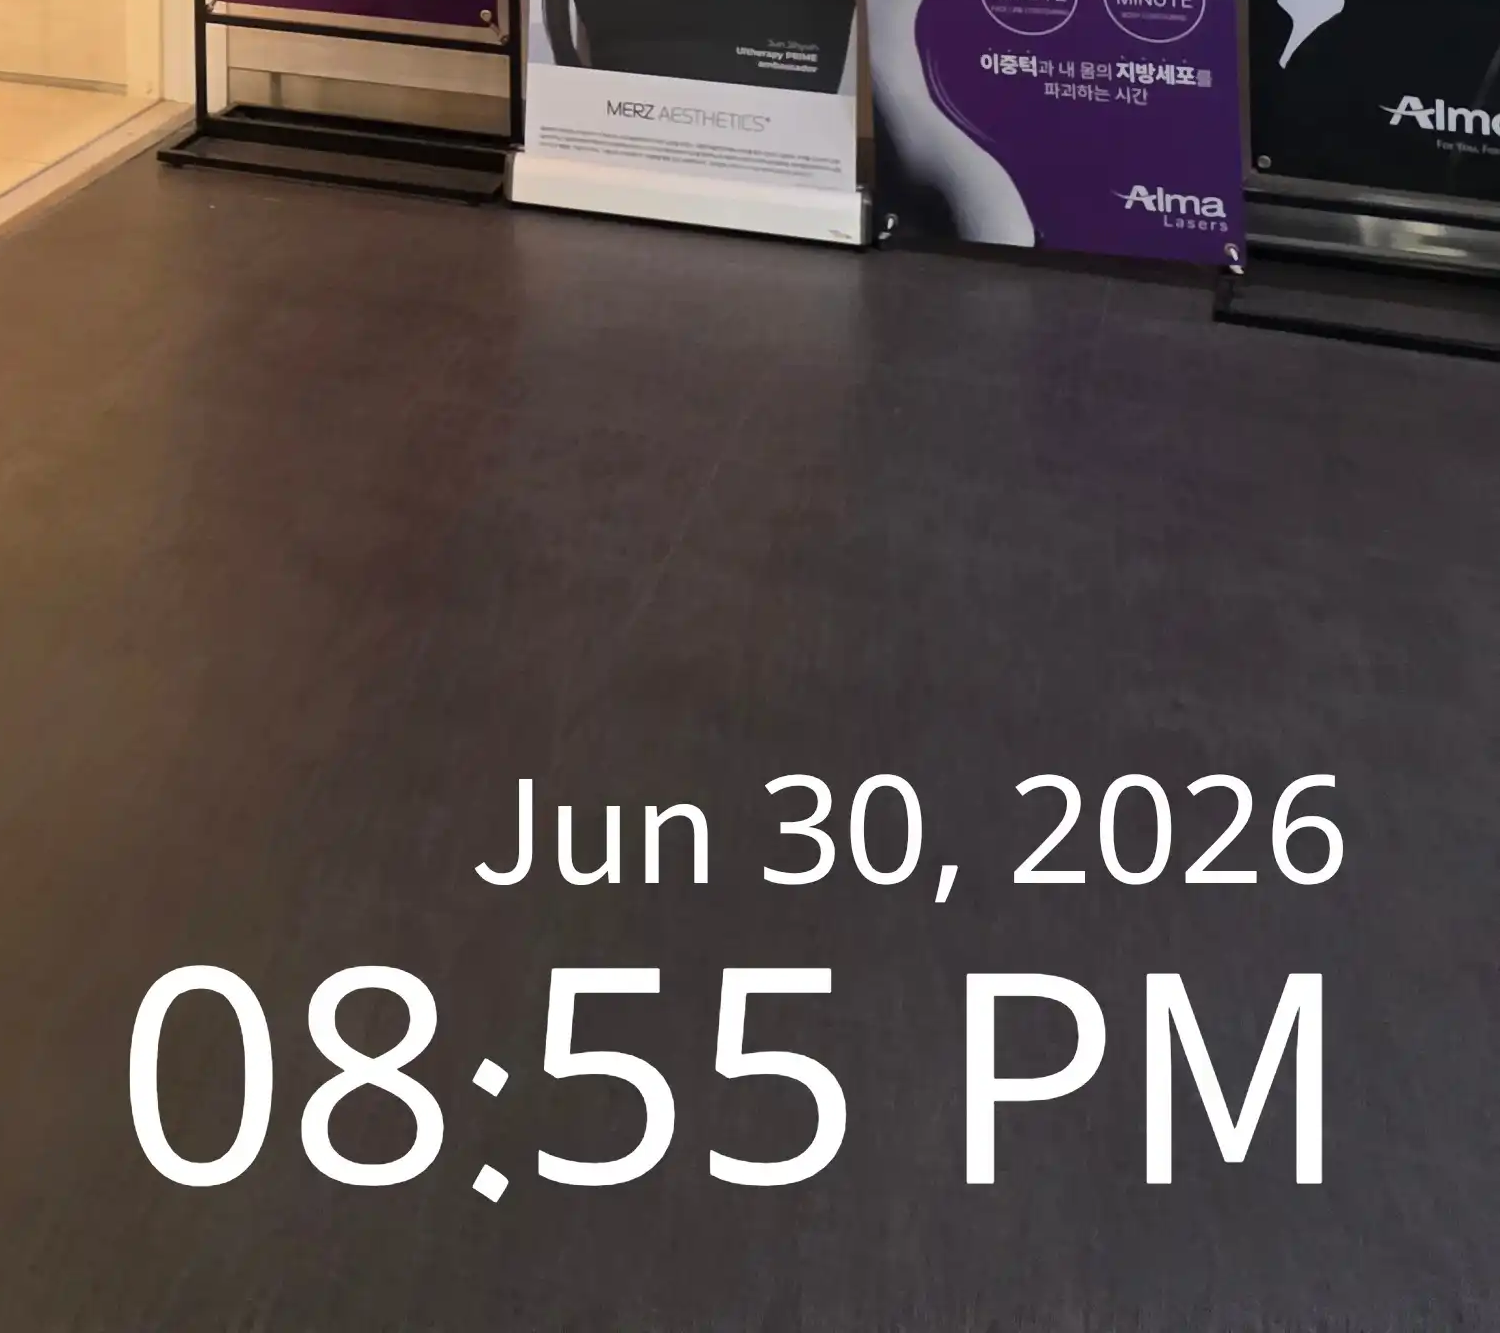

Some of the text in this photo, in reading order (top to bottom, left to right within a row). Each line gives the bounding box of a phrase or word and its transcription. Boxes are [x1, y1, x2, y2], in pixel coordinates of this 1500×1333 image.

[980, 52, 1054, 78] 이중턱과
[1058, 61, 1075, 78] 내
[1115, 61, 1212, 88] 지방세포를
[1044, 82, 1148, 106] 파괴하는 시간
[606, 99, 765, 133] MERZ AESTHETICS
[1120, 184, 1227, 219] Alma
[1163, 214, 1229, 233] Lasers
